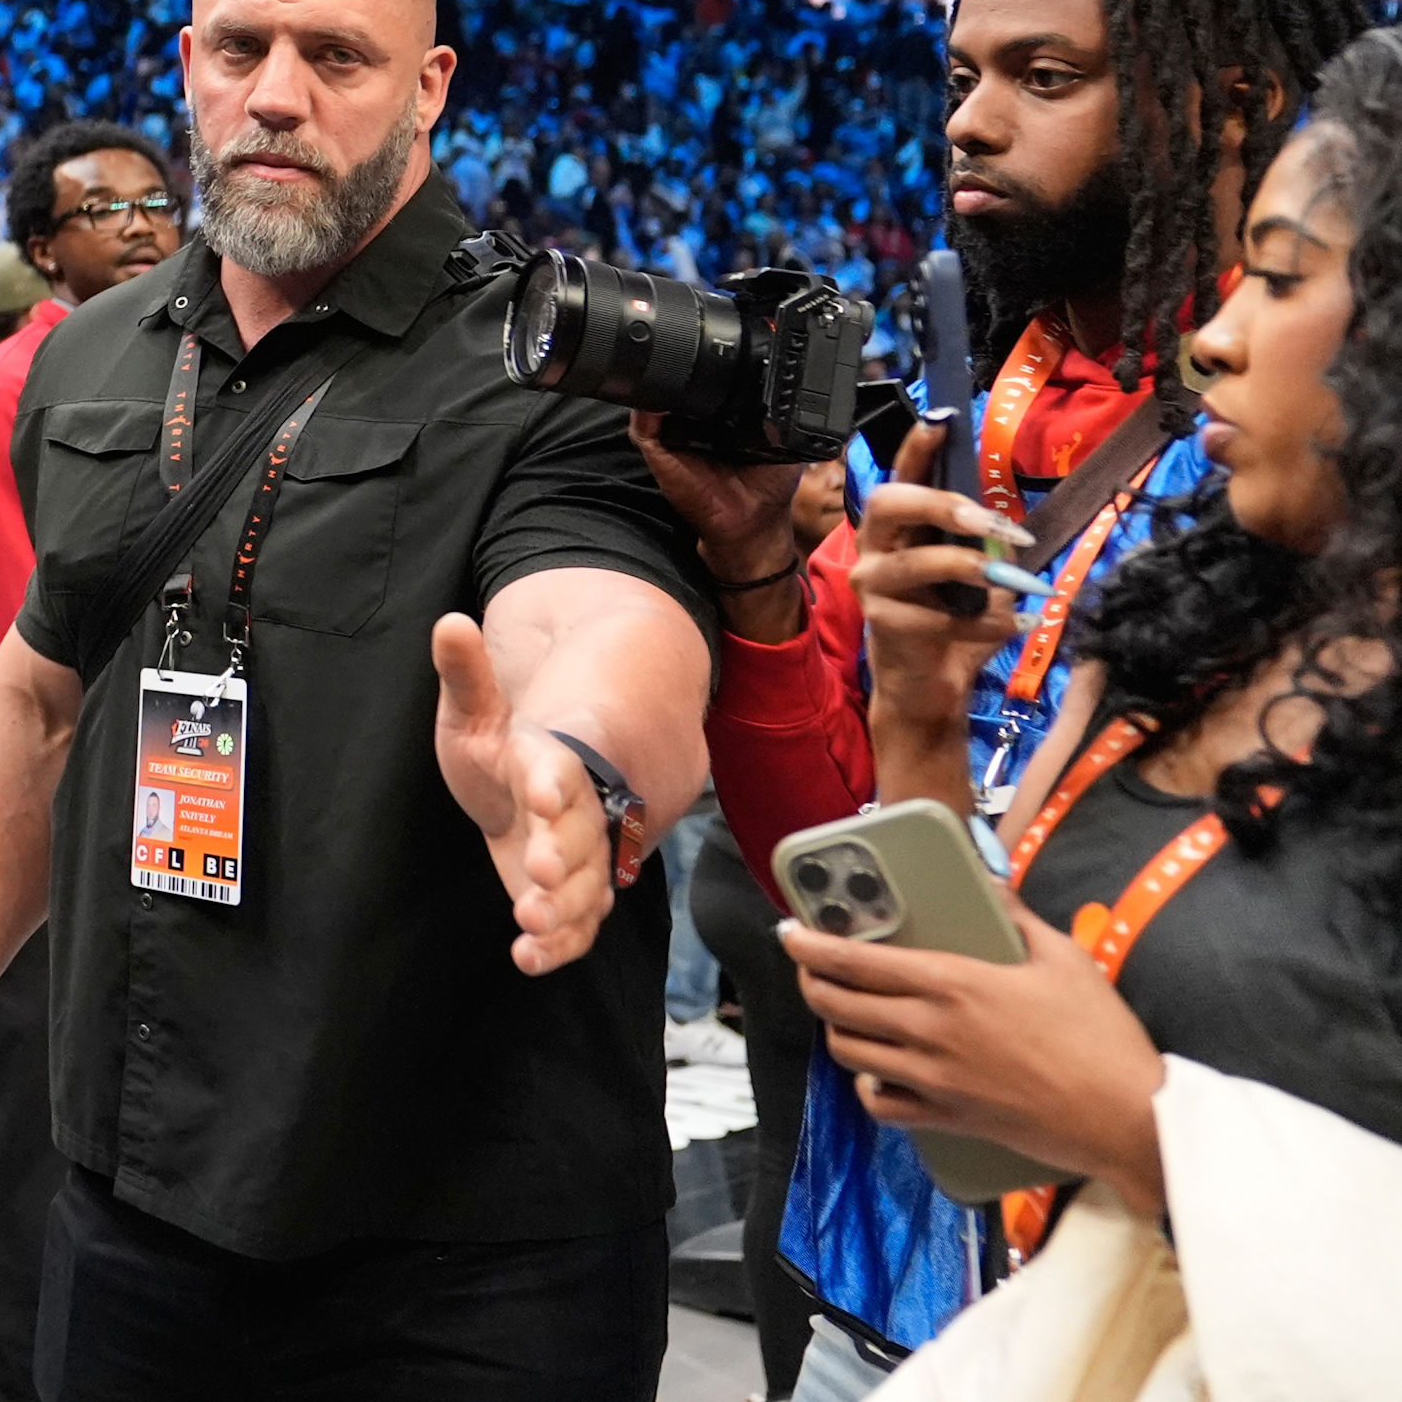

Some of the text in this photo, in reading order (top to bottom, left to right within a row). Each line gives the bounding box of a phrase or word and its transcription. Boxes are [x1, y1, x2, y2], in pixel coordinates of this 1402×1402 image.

[983, 453, 1017, 509] THIR
[148, 762, 230, 784] TEAM SECURITY
[178, 794, 226, 810] JONATHAN
[136, 844, 235, 878] C F L B E
